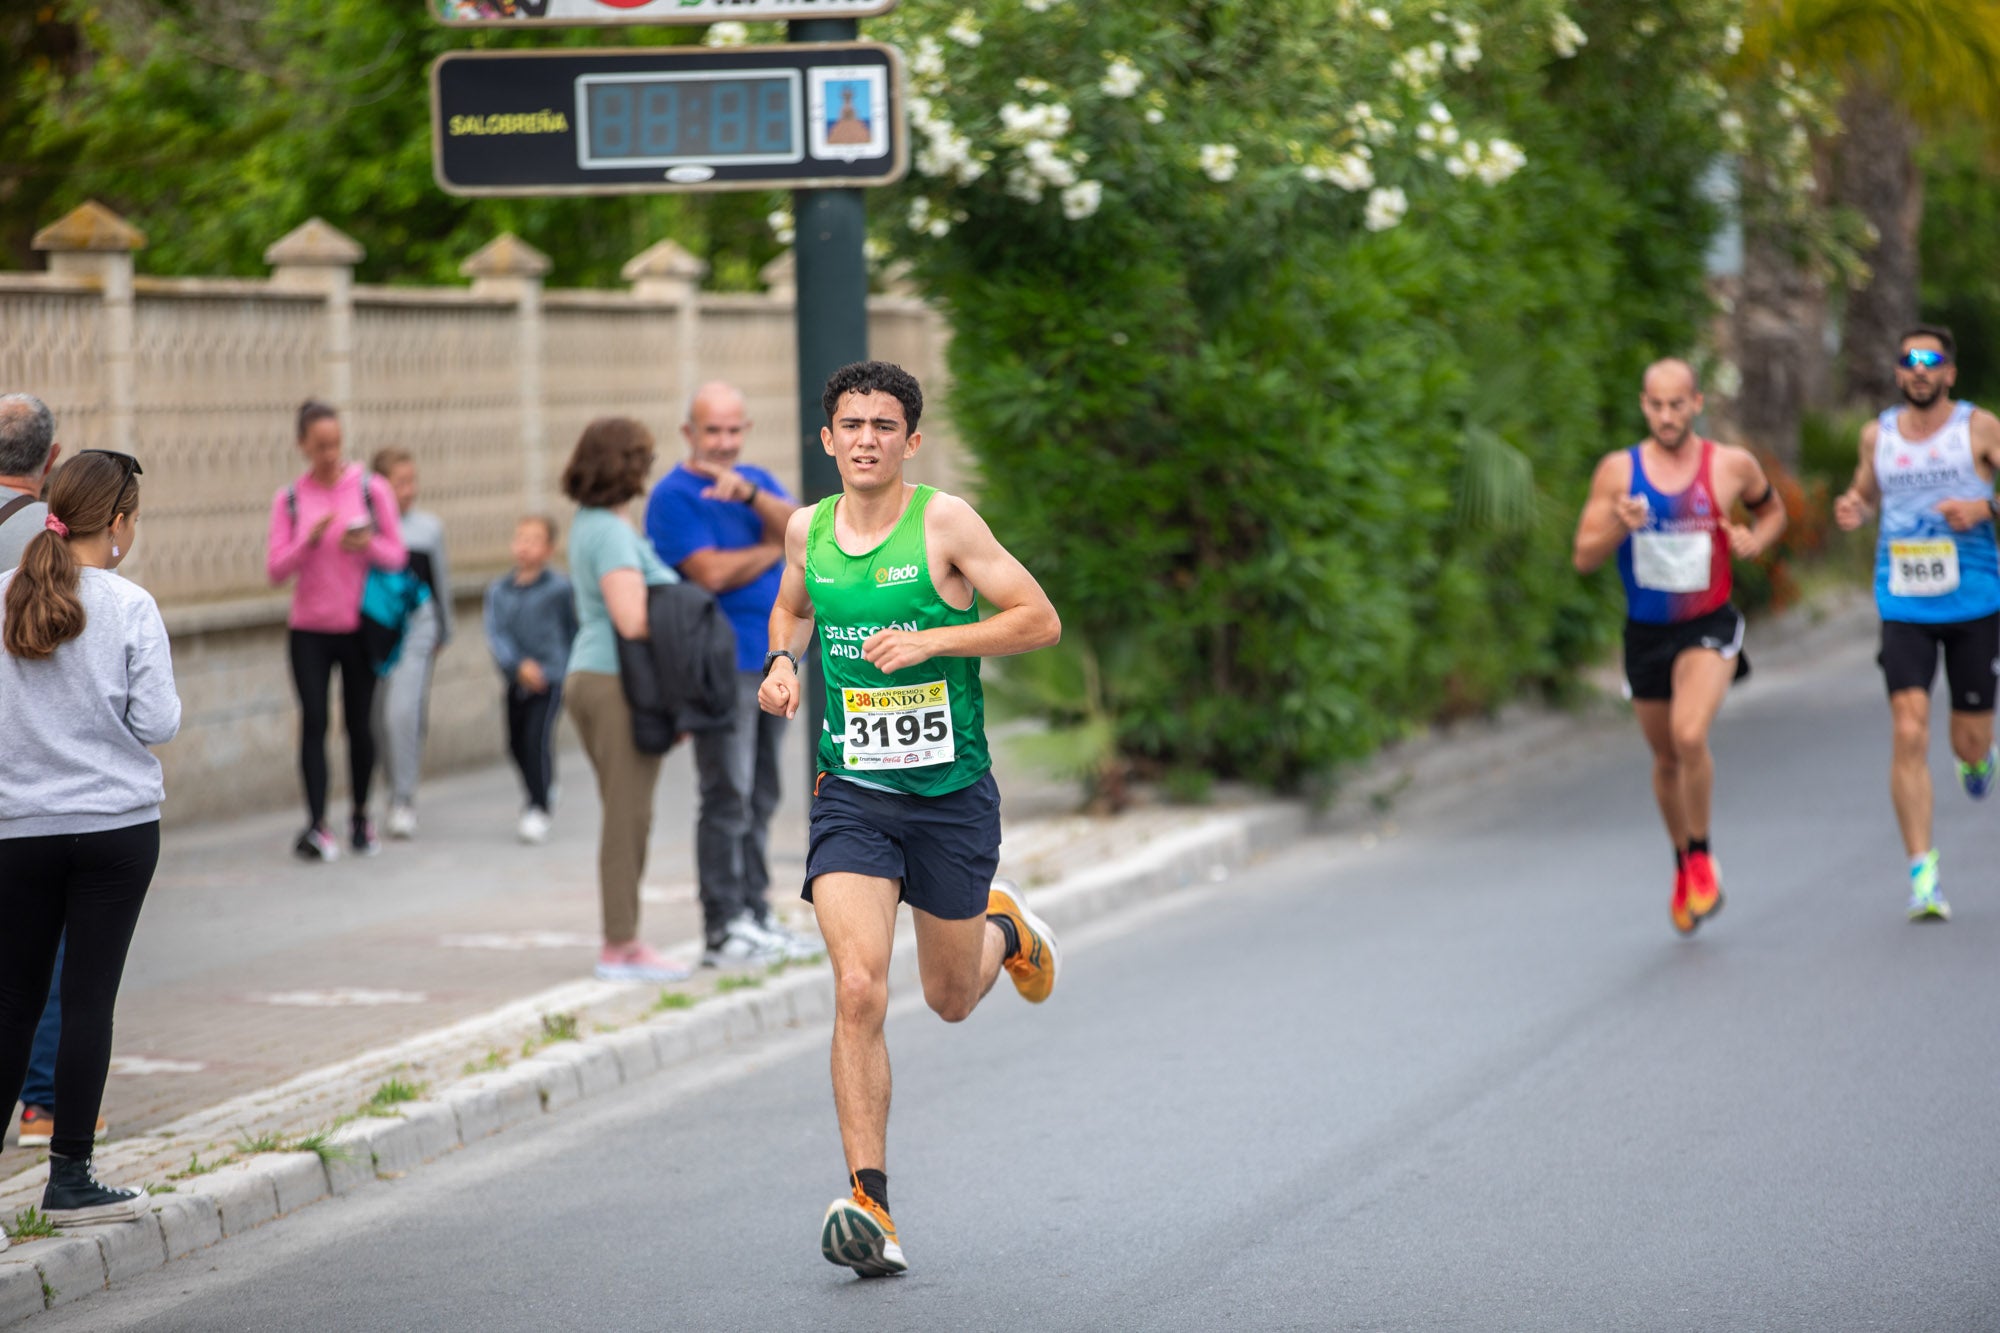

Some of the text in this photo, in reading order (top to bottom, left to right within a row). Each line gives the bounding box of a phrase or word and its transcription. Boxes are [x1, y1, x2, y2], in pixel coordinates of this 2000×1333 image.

[825, 620, 918, 641] SELECCÓN
[855, 693, 925, 708] 38 FONDO
[893, 688, 920, 696] PREMIO
[849, 711, 948, 748] 3195
